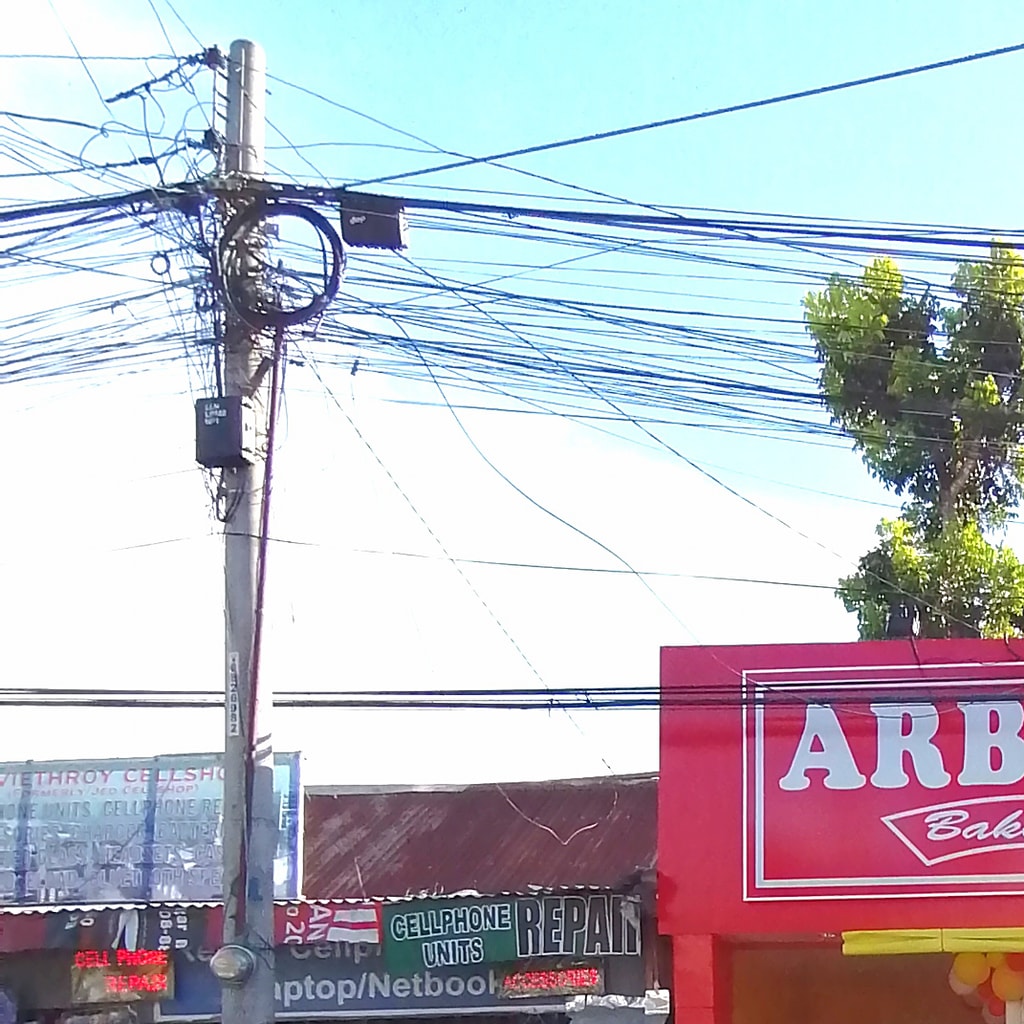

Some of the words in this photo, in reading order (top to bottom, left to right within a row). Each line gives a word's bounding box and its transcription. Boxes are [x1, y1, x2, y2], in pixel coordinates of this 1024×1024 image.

[391, 904, 511, 942] CELLPHONE
[74, 951, 111, 968] CELL
[422, 937, 485, 969] UNITS
